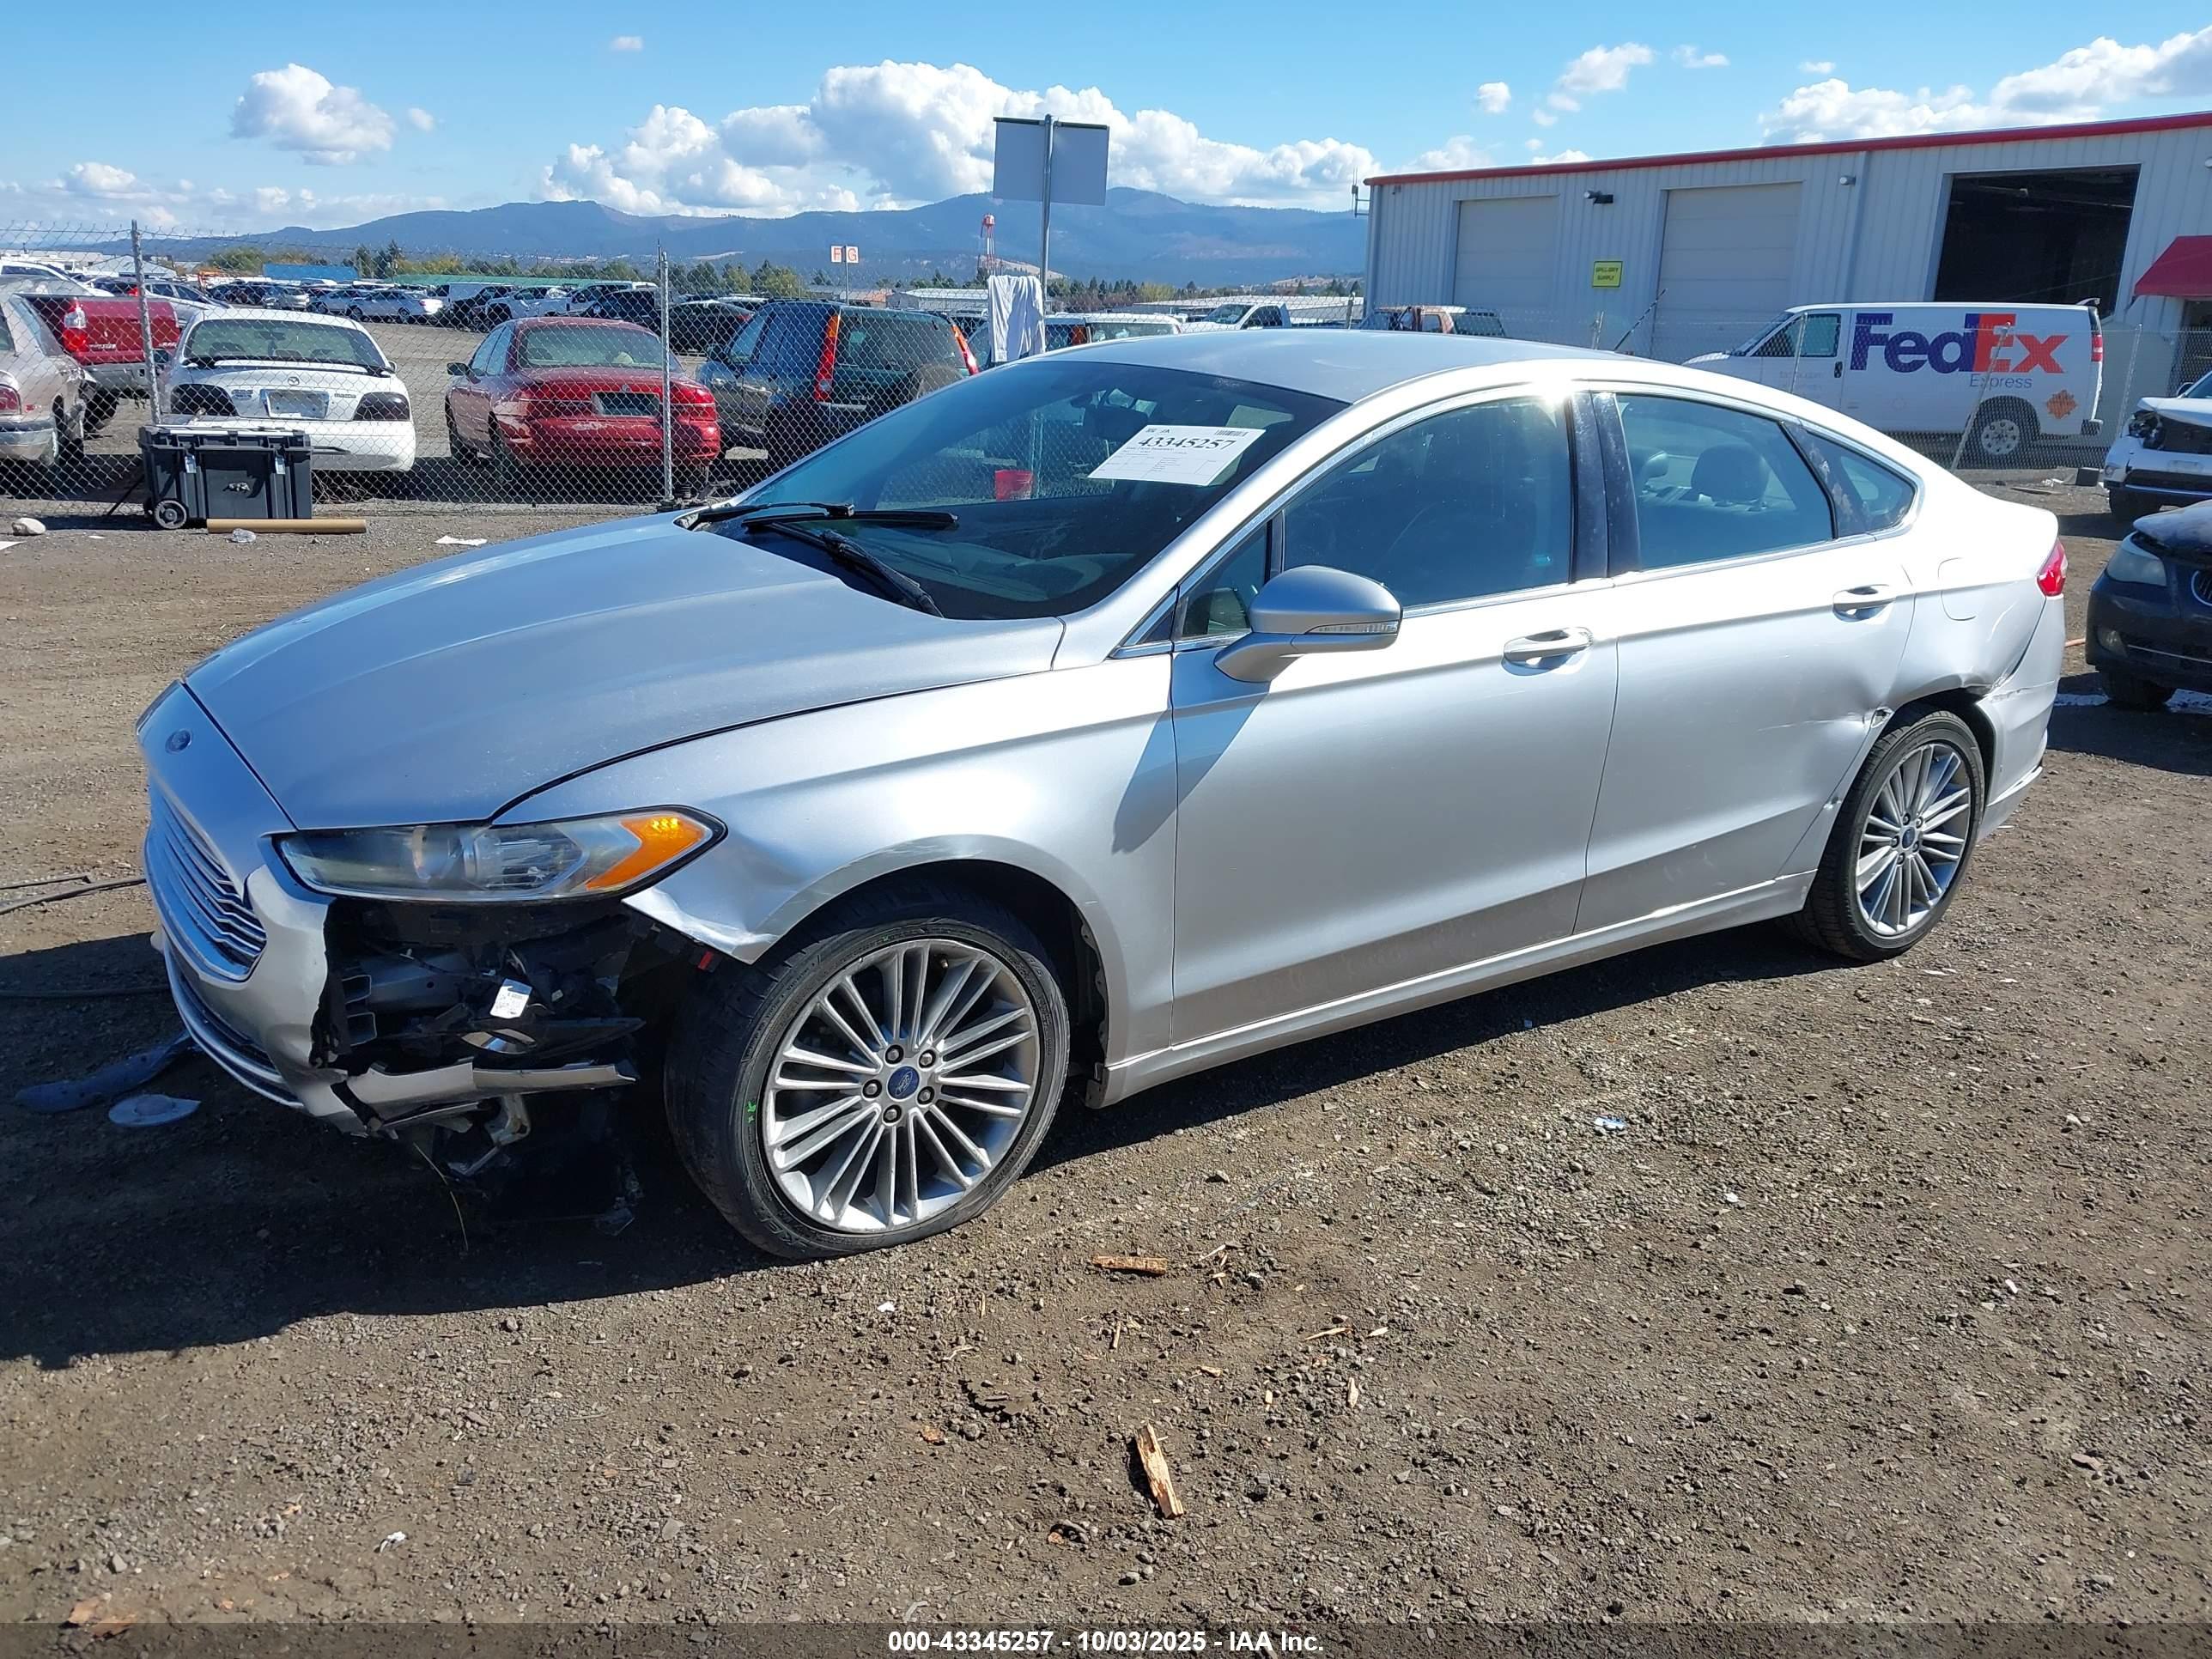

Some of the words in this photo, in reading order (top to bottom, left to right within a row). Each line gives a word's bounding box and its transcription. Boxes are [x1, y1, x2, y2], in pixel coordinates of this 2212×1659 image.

[833, 247, 842, 261] F
[848, 247, 857, 262] G
[1850, 313, 2069, 374] FedEx
[1138, 436, 1237, 450] 43345257
